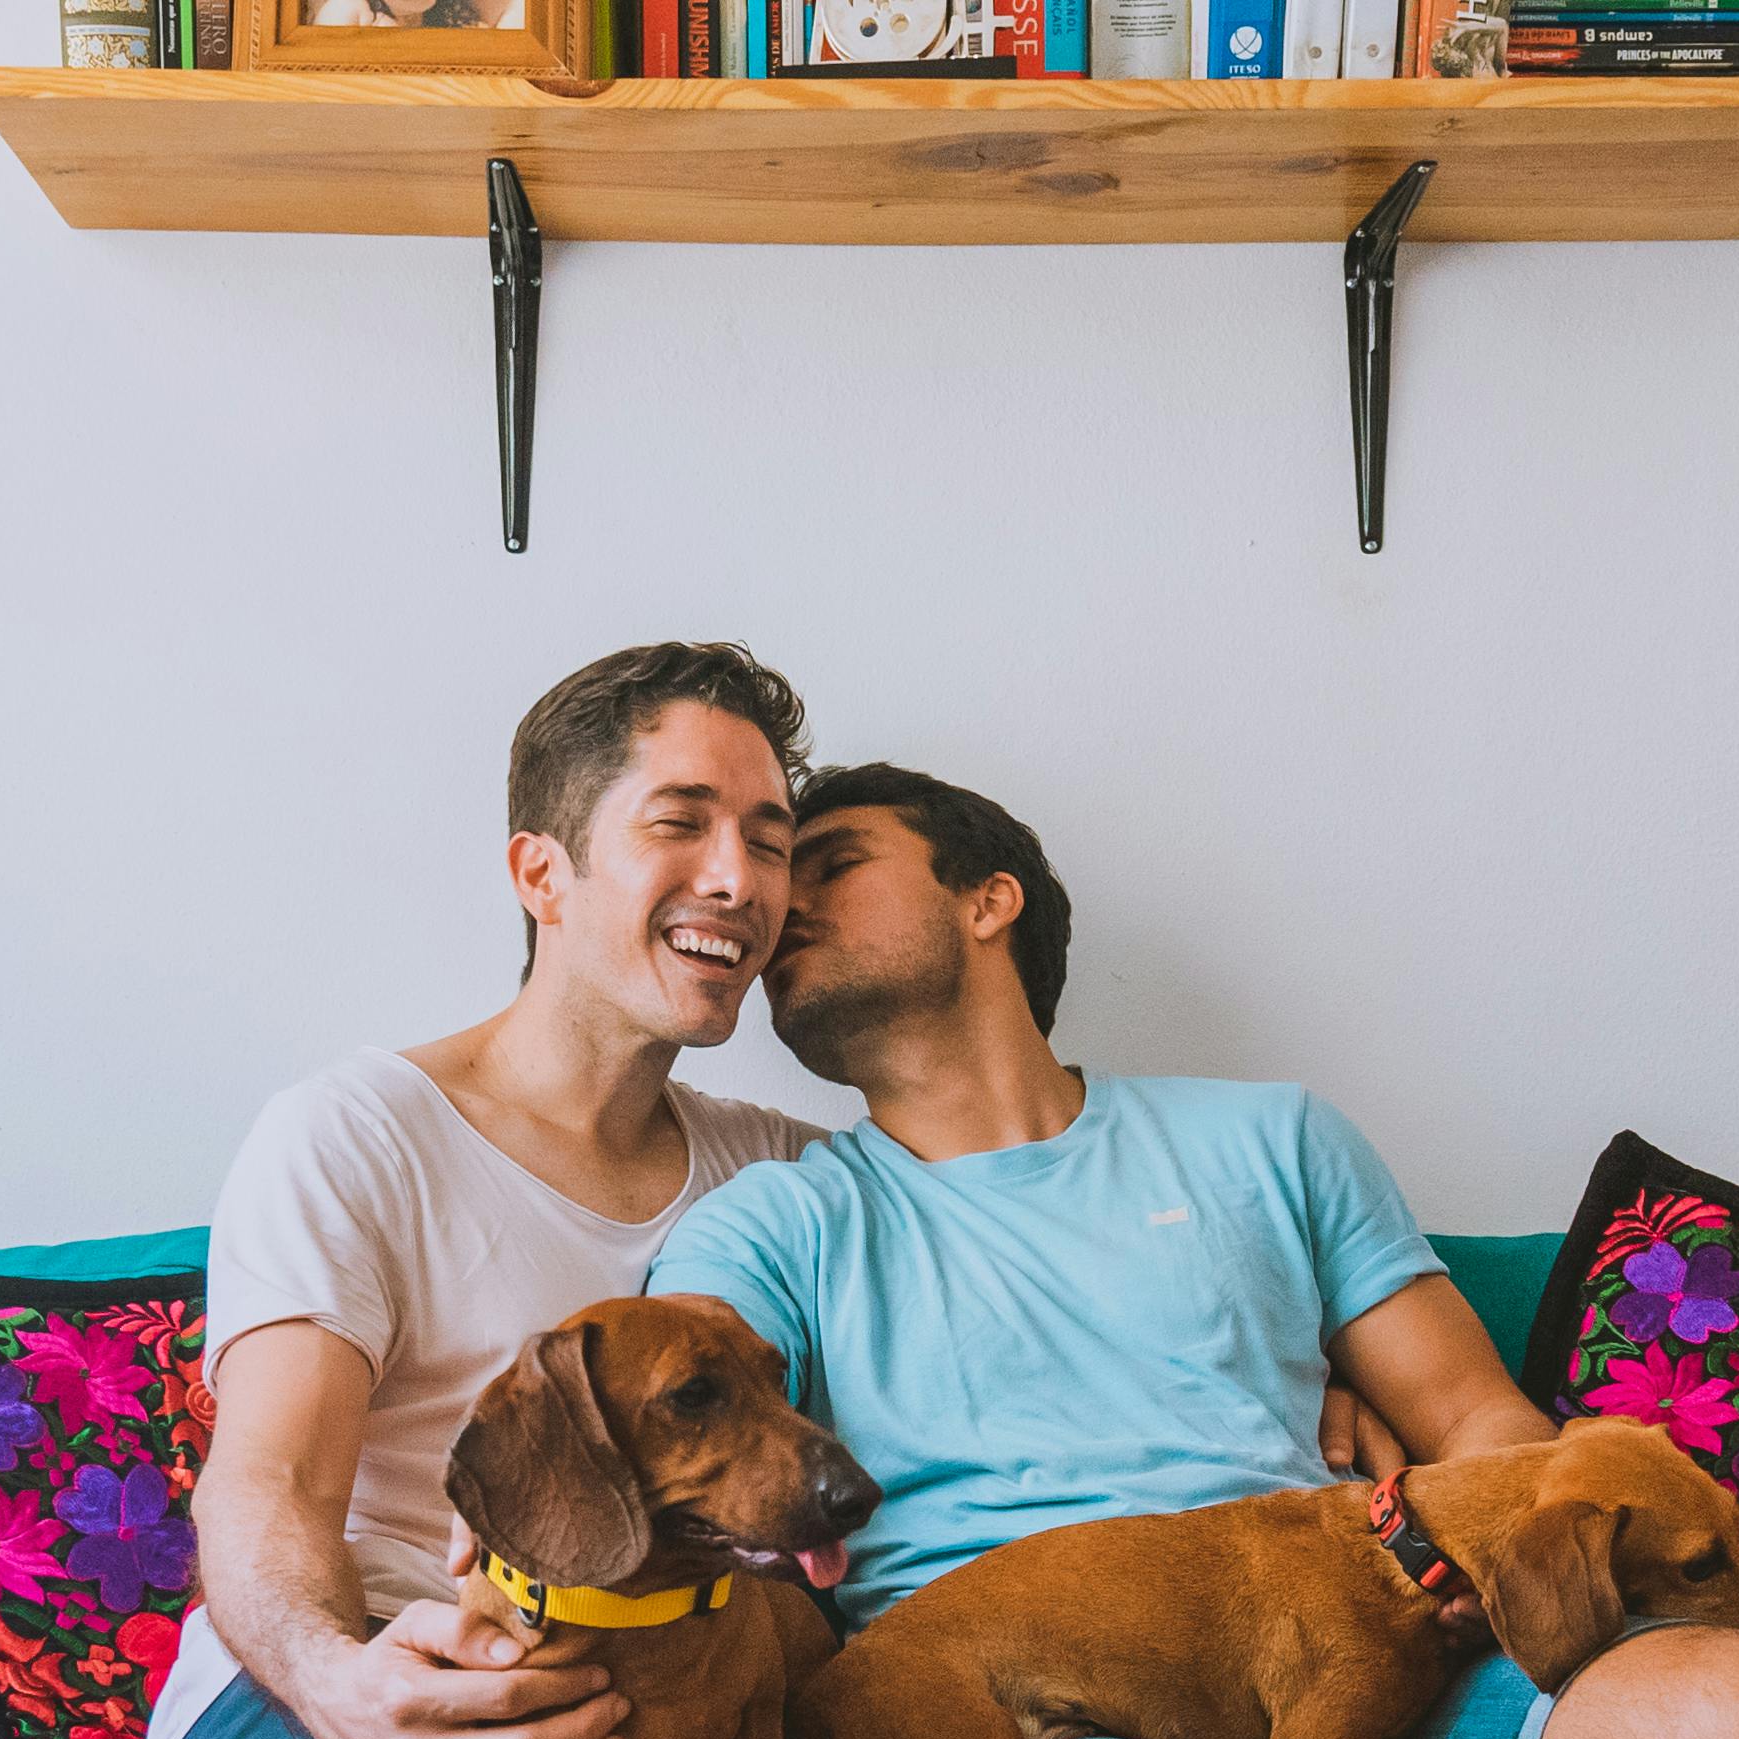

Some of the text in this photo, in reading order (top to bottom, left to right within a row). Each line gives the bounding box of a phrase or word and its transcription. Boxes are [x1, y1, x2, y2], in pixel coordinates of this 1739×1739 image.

[1584, 29, 1653, 43] campus B
[1617, 49, 1651, 60] PRINCES
[1672, 49, 1724, 60] APOCALYPSE
[1228, 64, 1261, 74] ITESO
